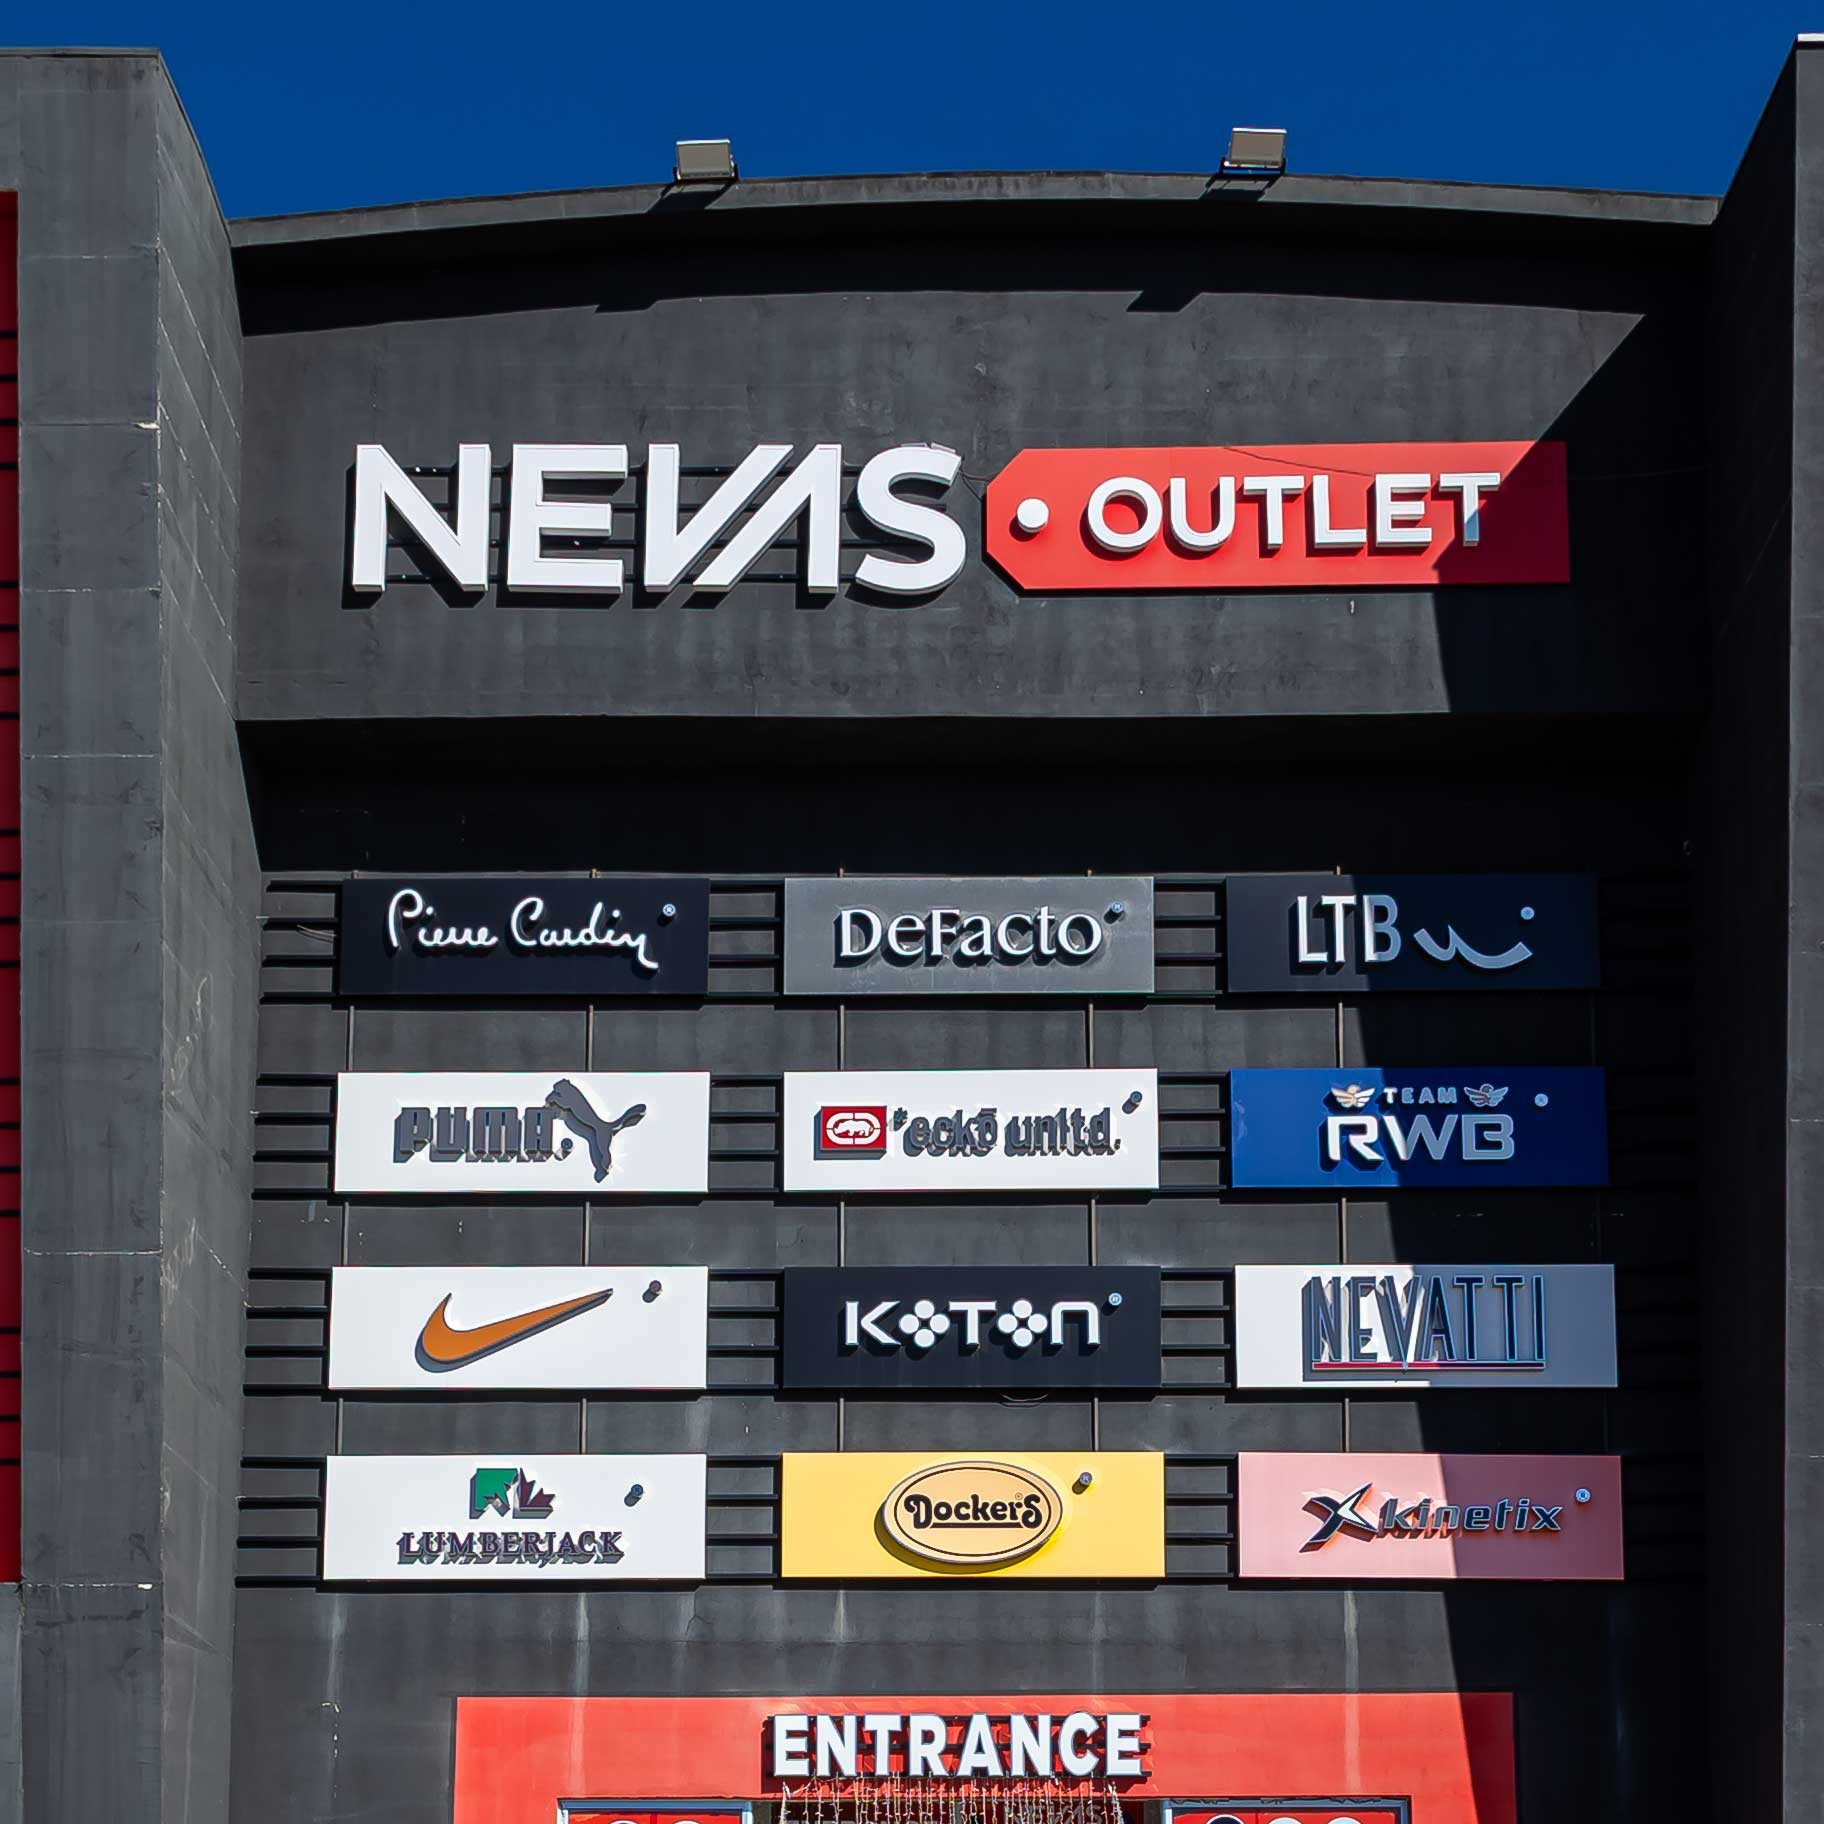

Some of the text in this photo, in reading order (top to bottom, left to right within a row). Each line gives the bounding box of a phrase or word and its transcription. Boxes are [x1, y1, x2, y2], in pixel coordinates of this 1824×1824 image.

[353, 443, 1501, 593] NEVAS OUTLET
[510, 896, 660, 970] Cardin
[840, 906, 1103, 958] DeFacto
[1297, 894, 1401, 963] LTB
[1383, 1087, 1457, 1105] TEAM
[403, 1106, 564, 1154] PUMA
[1327, 1114, 1514, 1160] RWB
[846, 1300, 1099, 1348] KOTON
[1311, 1275, 1546, 1366] NEVATTI
[1382, 1498, 1563, 1532] kinetix
[401, 1531, 625, 1563] LUMBERJACK
[774, 1713, 1145, 1778] ENTRANCE
